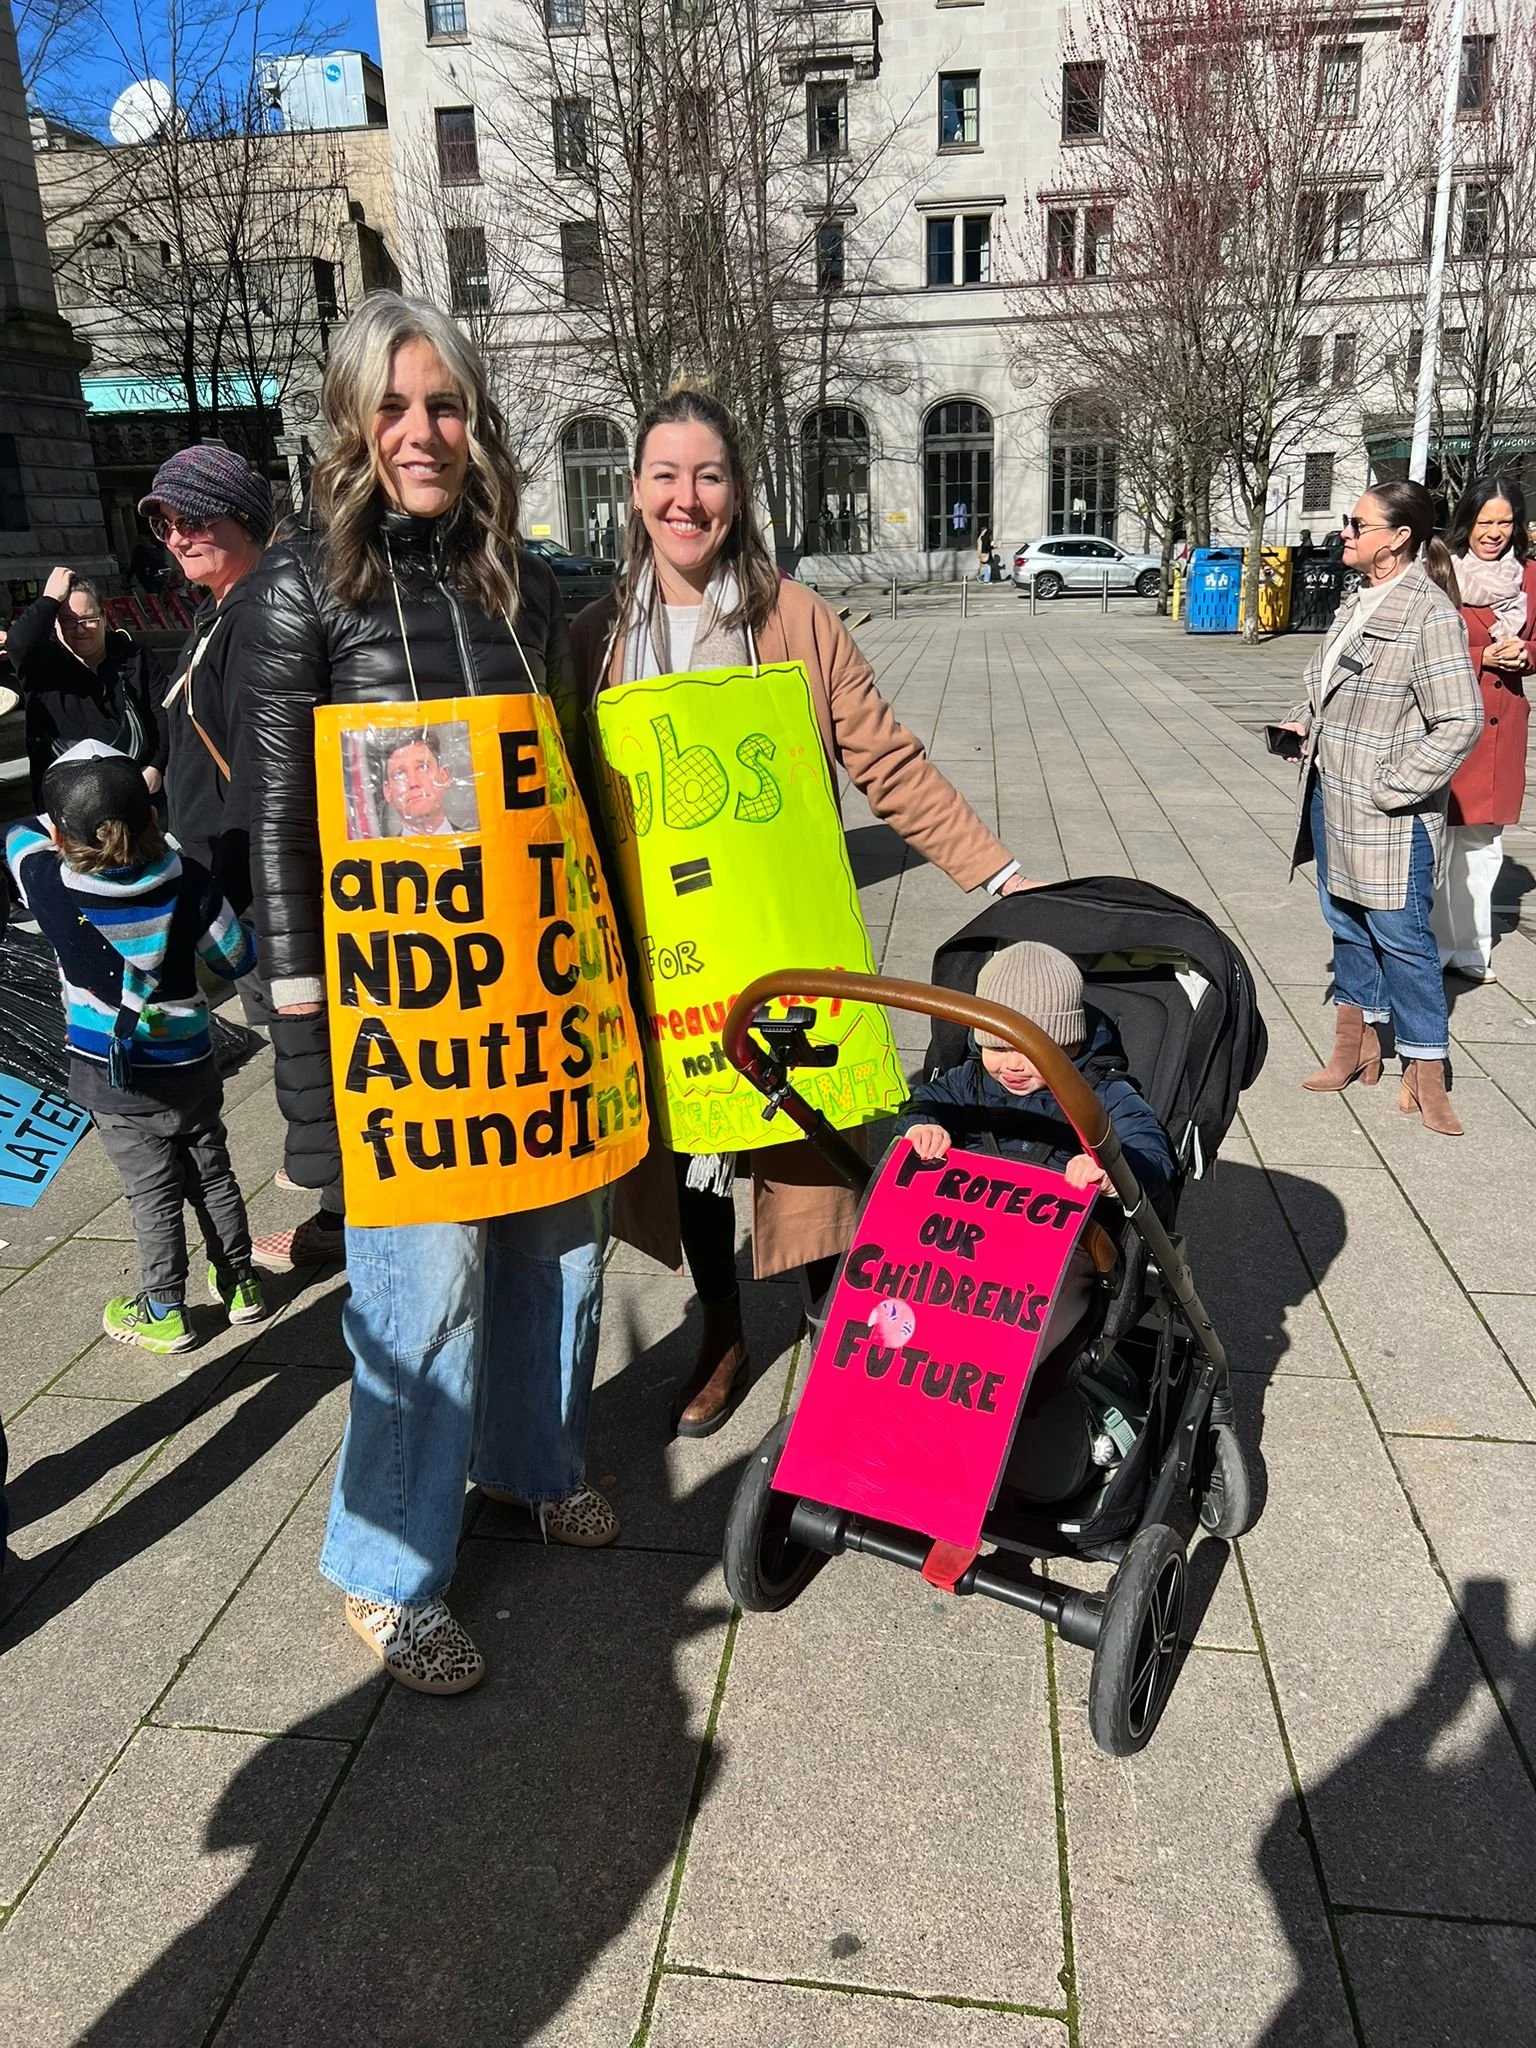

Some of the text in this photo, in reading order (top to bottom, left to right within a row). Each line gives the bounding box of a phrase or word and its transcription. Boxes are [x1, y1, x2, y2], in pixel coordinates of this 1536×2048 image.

[330, 846, 484, 923] and
[338, 930, 504, 1010] NDP
[641, 936, 705, 982] FOR
[682, 1041, 727, 1079] not
[895, 1144, 1086, 1230] PROTECT
[919, 1213, 986, 1261] OUR
[832, 1319, 1005, 1414] FUTURE
